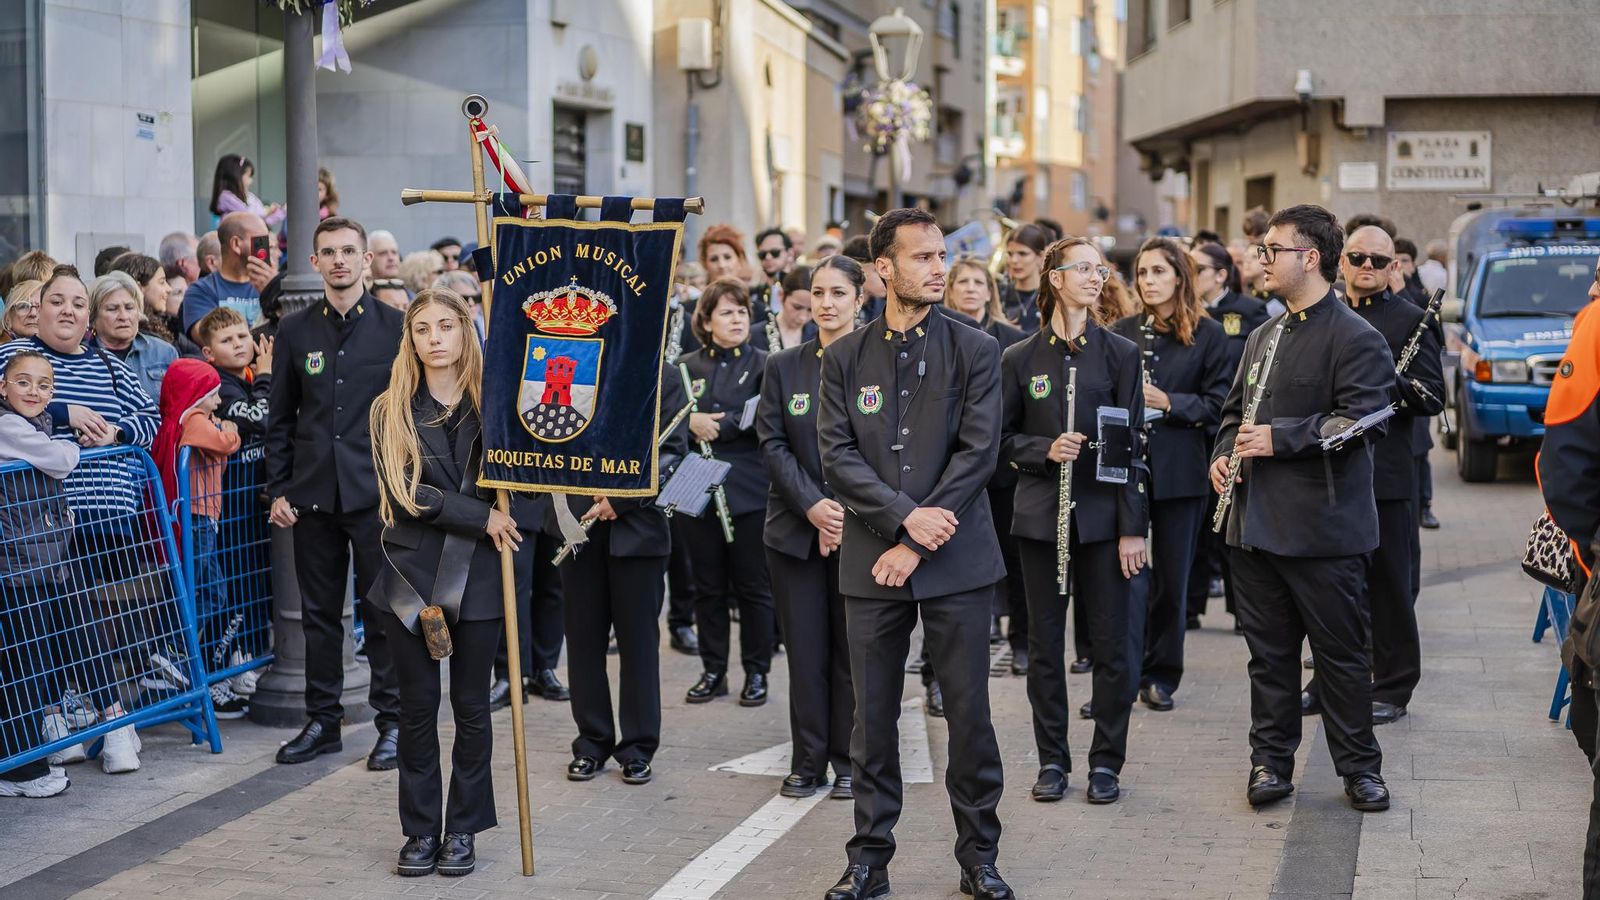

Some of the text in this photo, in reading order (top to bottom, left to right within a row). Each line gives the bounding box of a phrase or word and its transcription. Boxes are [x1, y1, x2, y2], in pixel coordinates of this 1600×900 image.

[502, 243, 647, 296] UNION MUSICAL
[487, 449, 640, 475] ROQUETAS DE MAR
